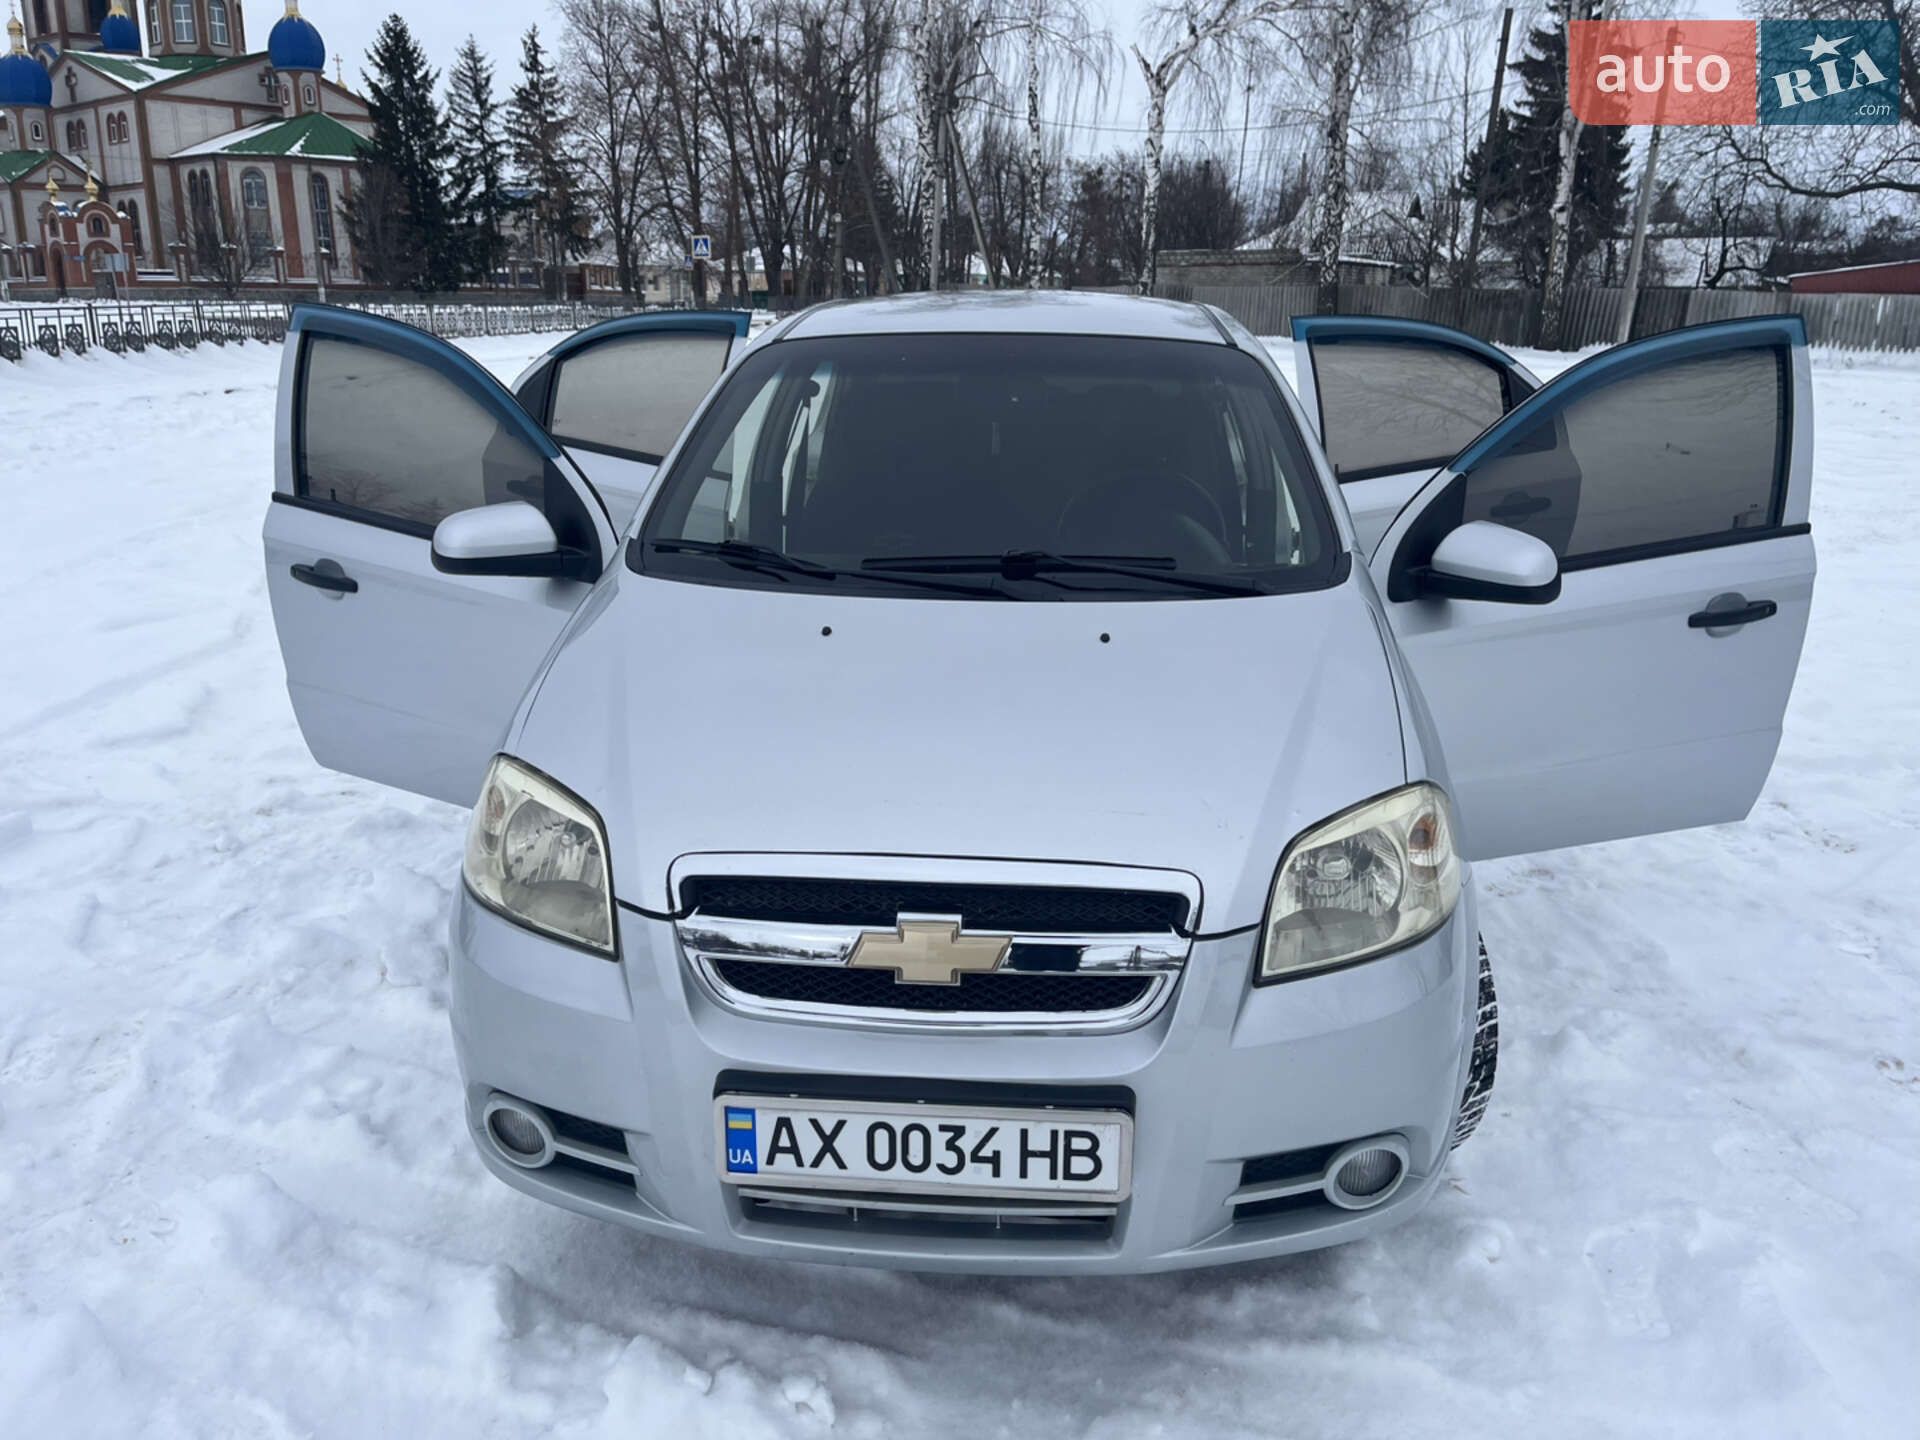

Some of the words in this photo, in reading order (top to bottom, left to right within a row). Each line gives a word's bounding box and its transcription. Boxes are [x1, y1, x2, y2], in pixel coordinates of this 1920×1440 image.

[728, 1149, 754, 1165] UA
[765, 1116, 848, 1170] AX
[866, 1121, 1001, 1178] 0034
[1018, 1128, 1103, 1182] HB
